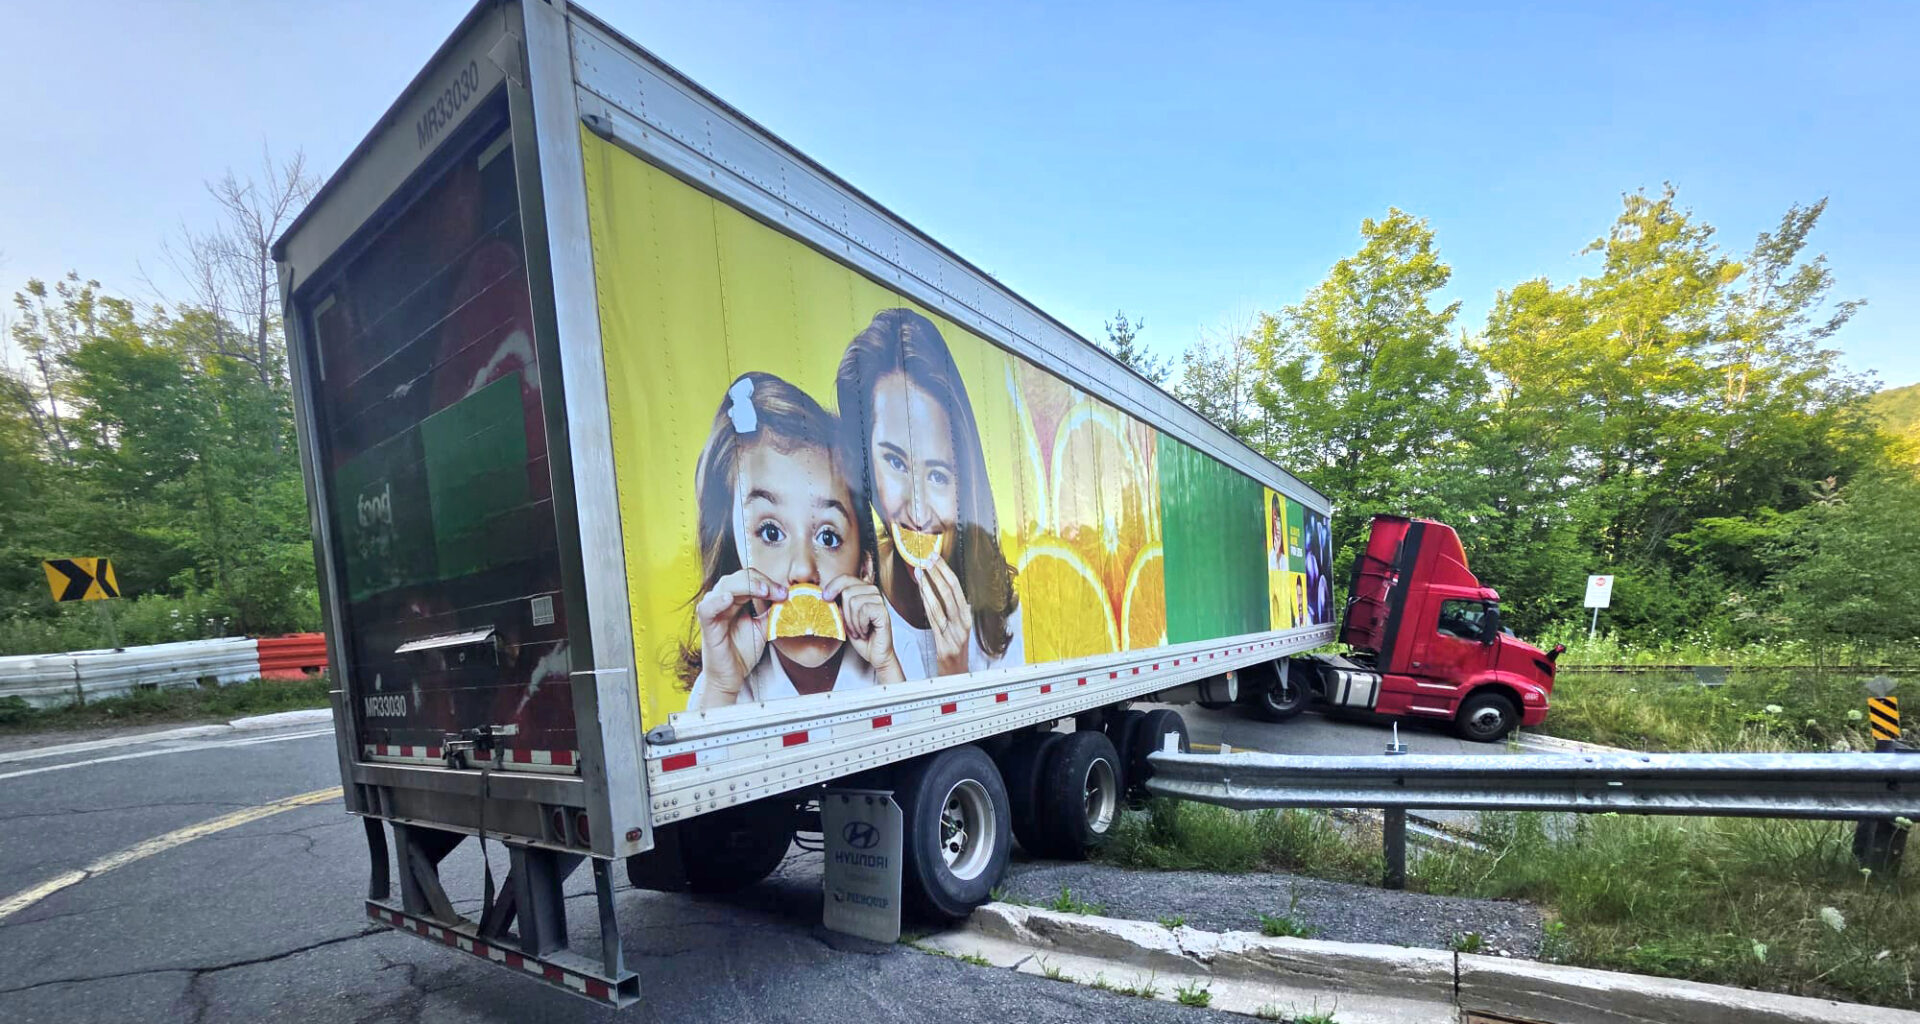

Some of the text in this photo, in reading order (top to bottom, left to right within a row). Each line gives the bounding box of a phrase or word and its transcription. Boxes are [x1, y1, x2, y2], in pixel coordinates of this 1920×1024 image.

[416, 60, 480, 151] MR33030
[364, 695, 407, 717] MR33030
[835, 850, 888, 869] HYUNDAI
